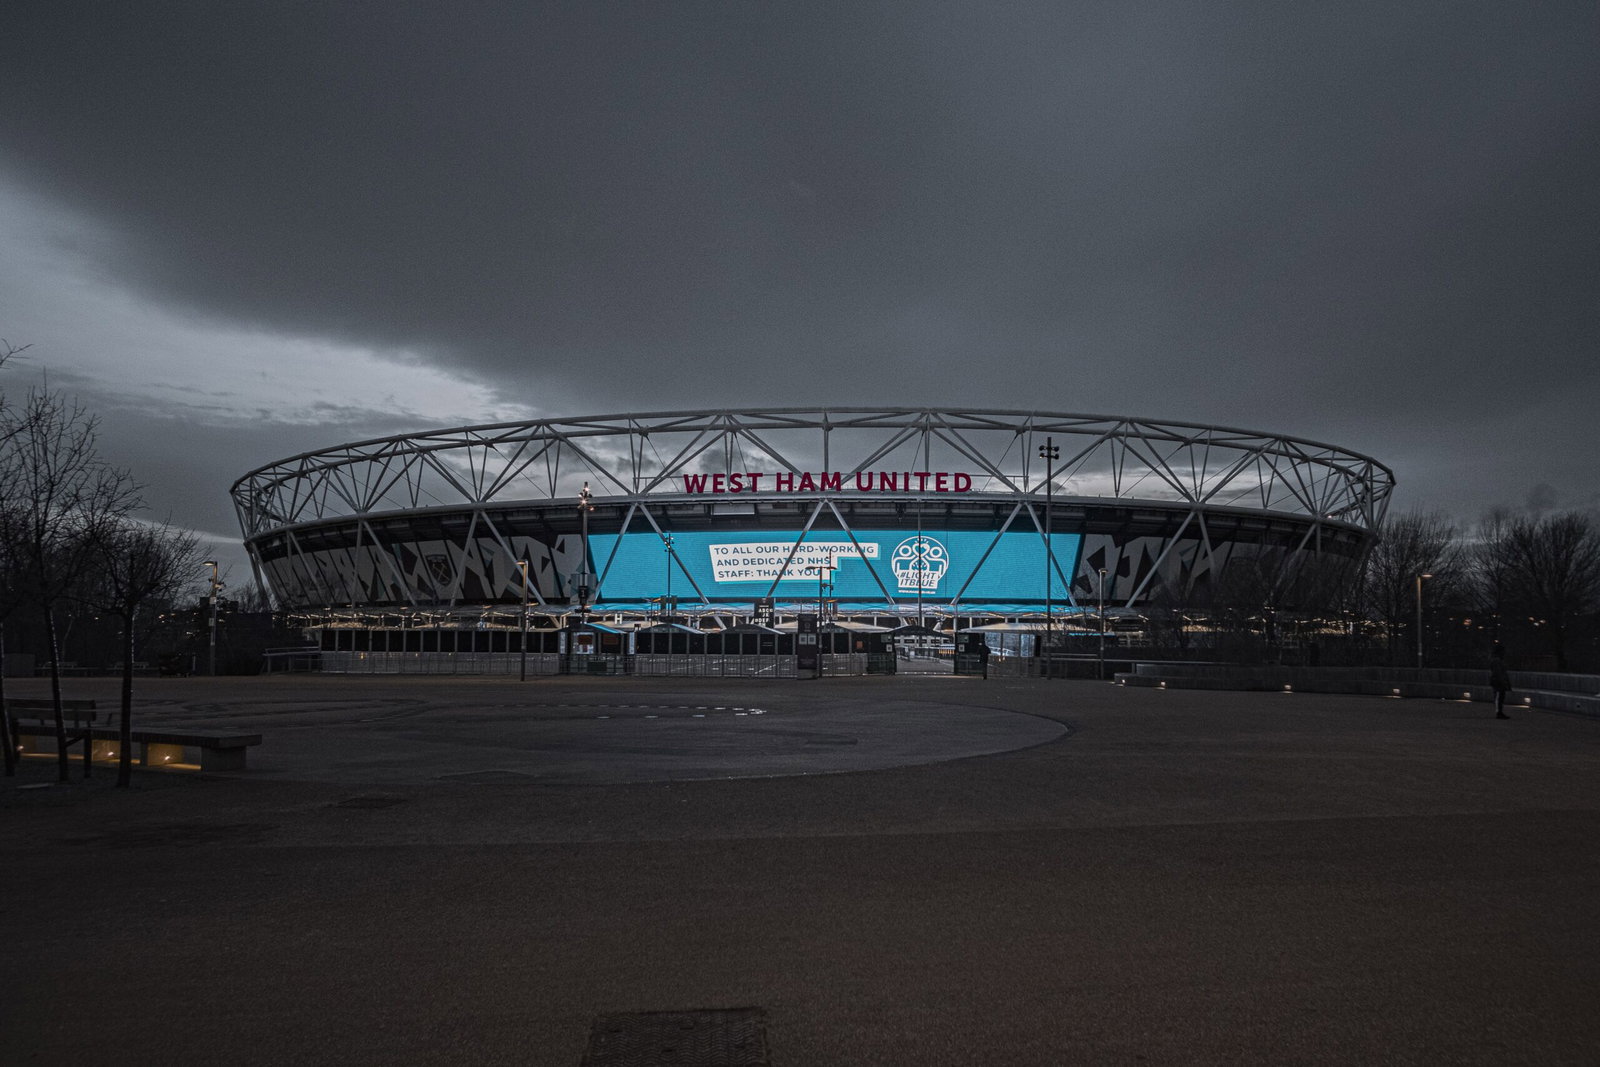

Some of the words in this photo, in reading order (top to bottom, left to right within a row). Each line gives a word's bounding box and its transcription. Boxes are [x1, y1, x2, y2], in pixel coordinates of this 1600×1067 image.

[683, 472, 763, 493] WEST
[776, 472, 842, 492] HAM
[856, 472, 972, 493] UNITED
[714, 547, 729, 555] TO
[756, 546, 779, 554] OUR
[743, 557, 804, 566] DEDICATED
[718, 570, 754, 578] STAFF:
[756, 569, 794, 577] THANK
